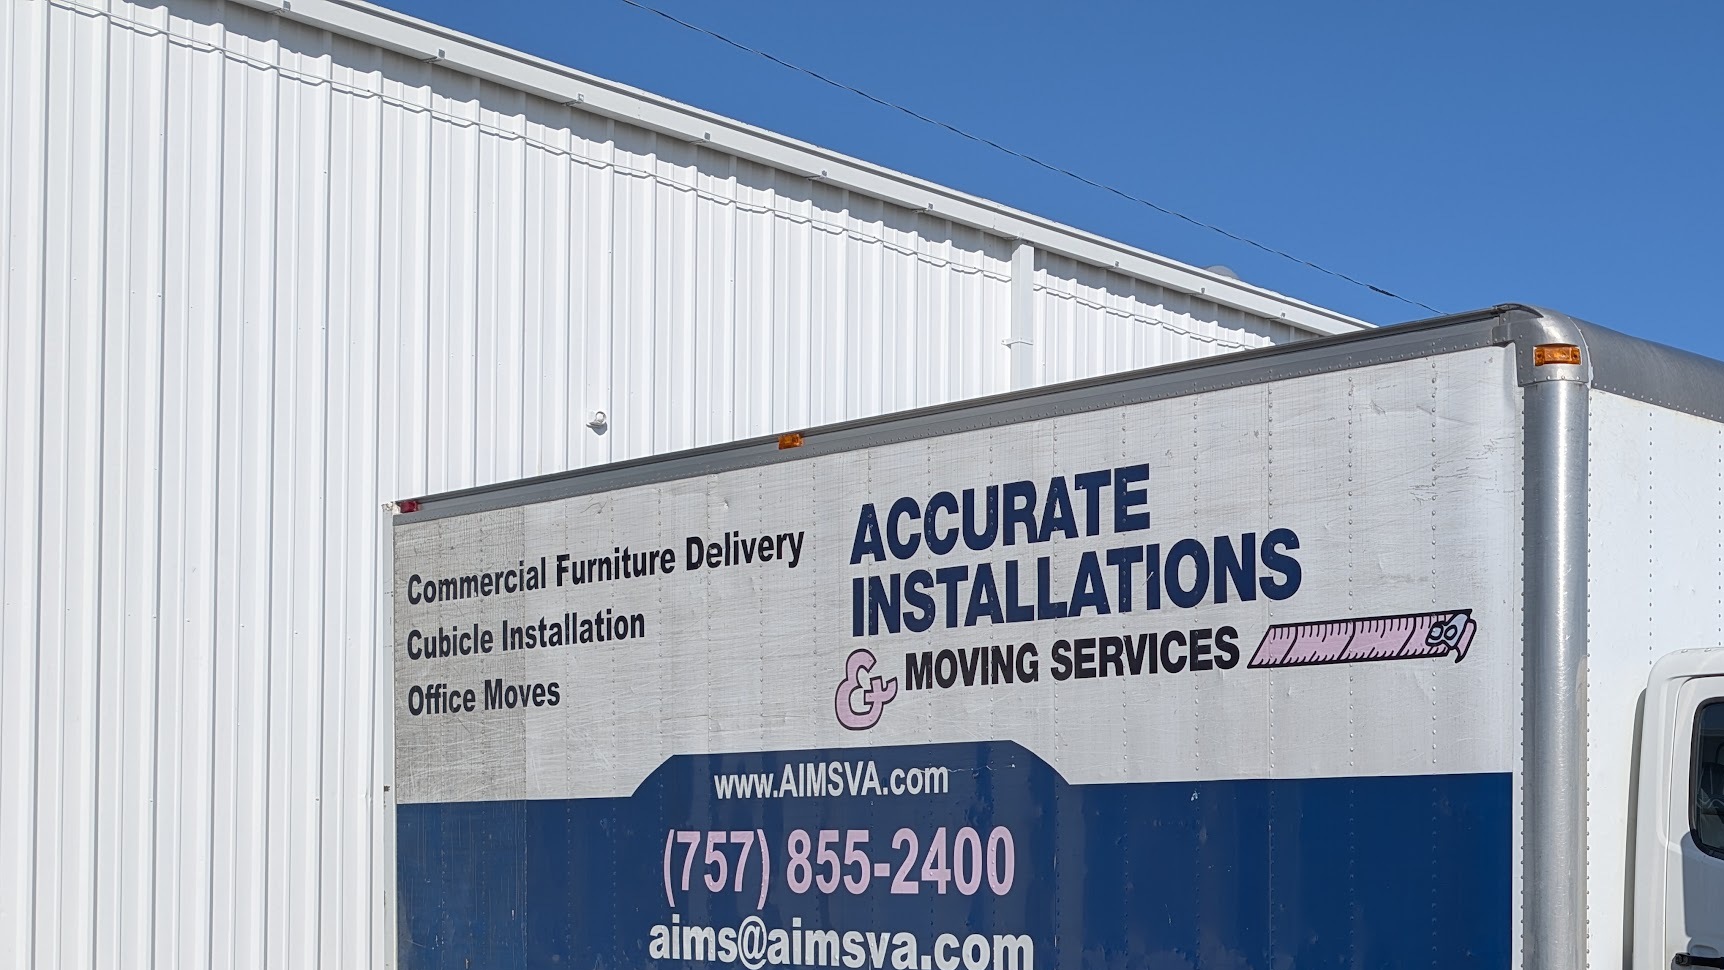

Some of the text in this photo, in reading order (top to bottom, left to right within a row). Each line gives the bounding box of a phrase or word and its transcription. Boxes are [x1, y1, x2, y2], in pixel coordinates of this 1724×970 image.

[850, 463, 1150, 565] ACCURATE
[407, 530, 805, 605] Commercial Furniture Delivery
[851, 528, 1302, 637] INSTALLATIONS
[407, 608, 645, 660] Cubicle Installation
[407, 678, 561, 717] Office Moves
[834, 625, 1240, 730] & MOVING SERVICES
[713, 760, 949, 800] www.AIMSVA.com
[663, 825, 1015, 909] (757) 855-2400
